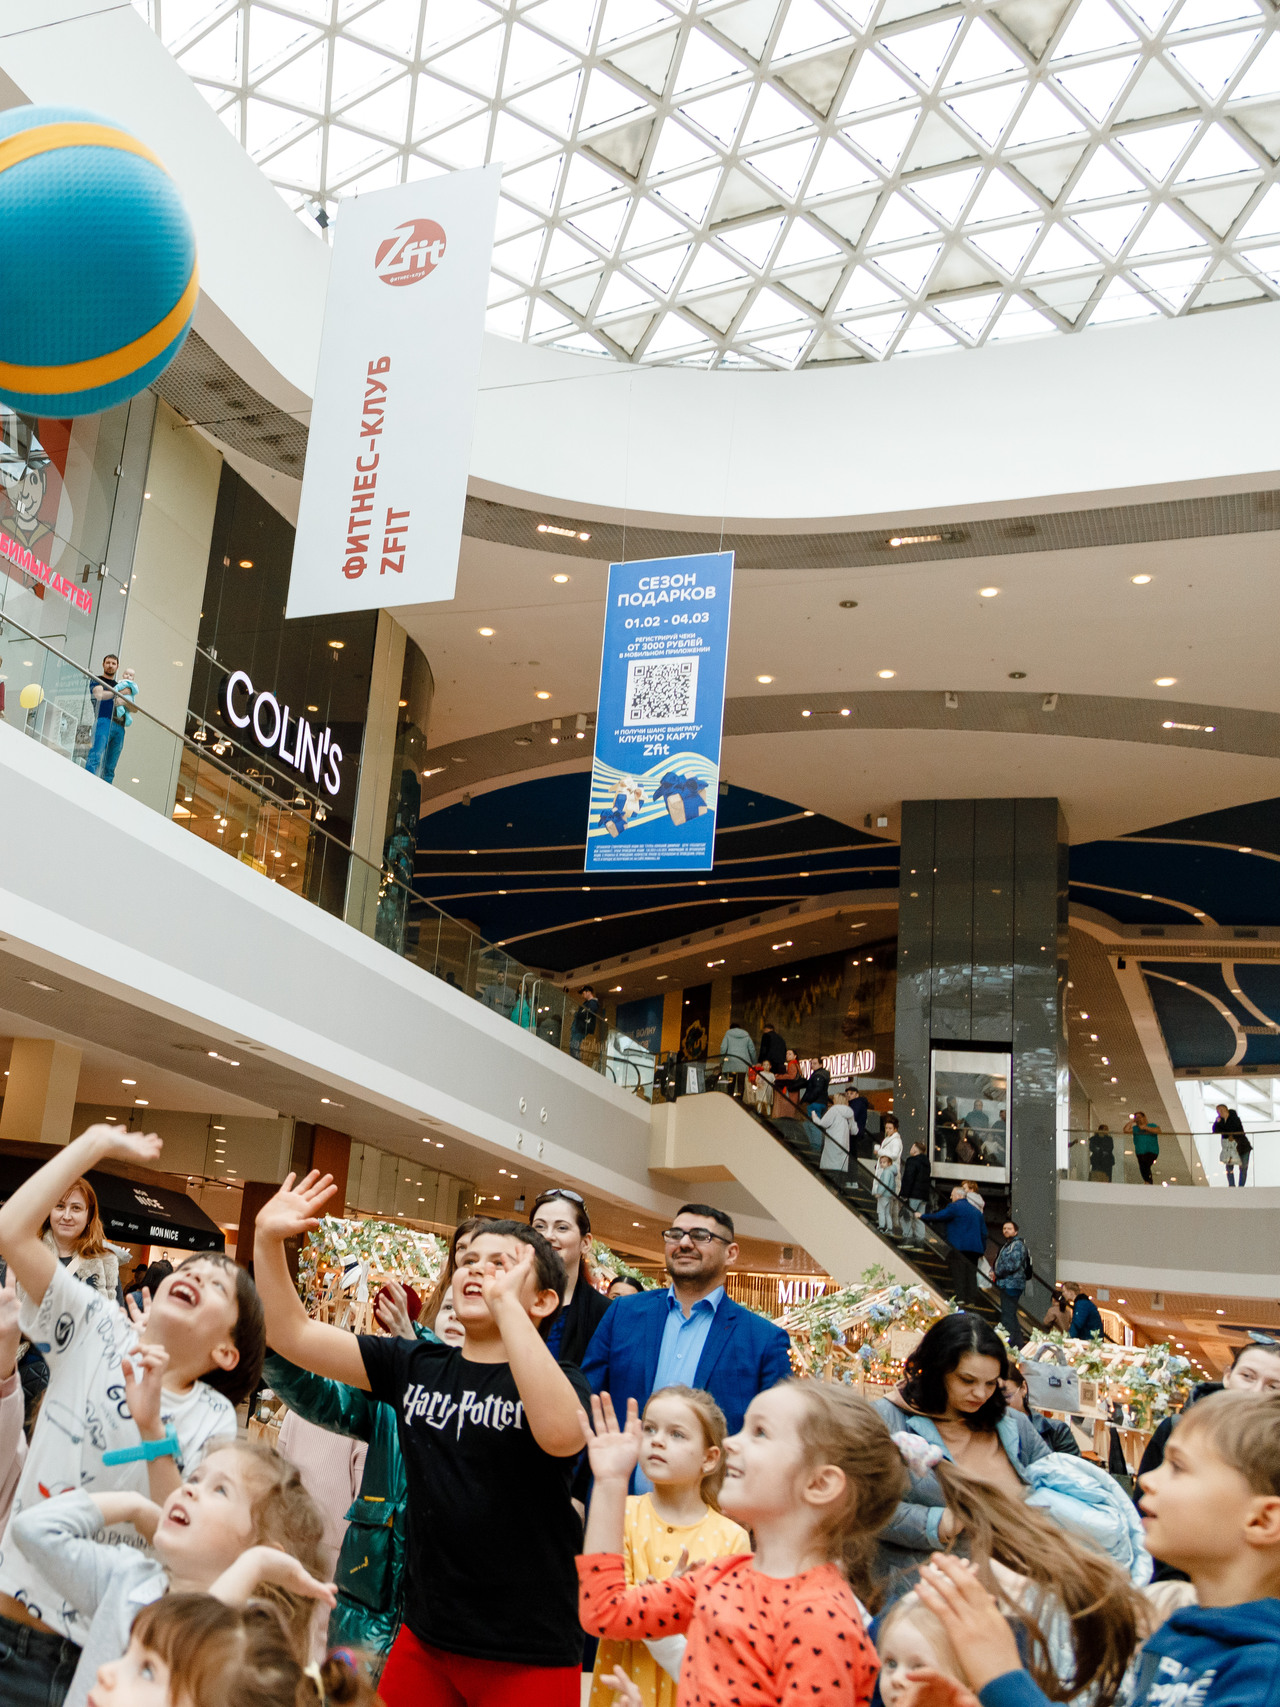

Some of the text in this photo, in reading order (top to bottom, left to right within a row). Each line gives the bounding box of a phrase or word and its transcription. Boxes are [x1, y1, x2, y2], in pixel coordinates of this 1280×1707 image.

[376, 224, 447, 277] Zfit
[341, 355, 392, 580] ФИТНЕС-КЛУБ
[380, 507, 411, 575] ZFIT
[638, 572, 697, 591] СЕЗОН
[50, 570, 94, 616] ДЕТЕЙ
[617, 586, 717, 608] ПОДАРКОВ
[624, 616, 661, 630] 01.02
[671, 612, 710, 627] 04.03
[627, 636, 703, 652] ОТ 3000 РУБЛЕЙ
[635, 632, 696, 643] РЕГИСТРИРУЙ ЧЕКИ
[624, 650, 665, 658] МОБИЛЬНОМ
[665, 646, 711, 655] ПРИЛОЖЕНИИ
[226, 670, 344, 796] COLIN'S
[618, 732, 698, 744] КЛУБНУЮ КАРТУ
[646, 726, 666, 734] ШАНС
[642, 743, 670, 757] Zfit
[798, 1049, 877, 1081] MRMELAD
[149, 1225, 165, 1238] MON
[163, 1228, 179, 1241] NICE
[402, 1382, 525, 1442] Harry Potter
